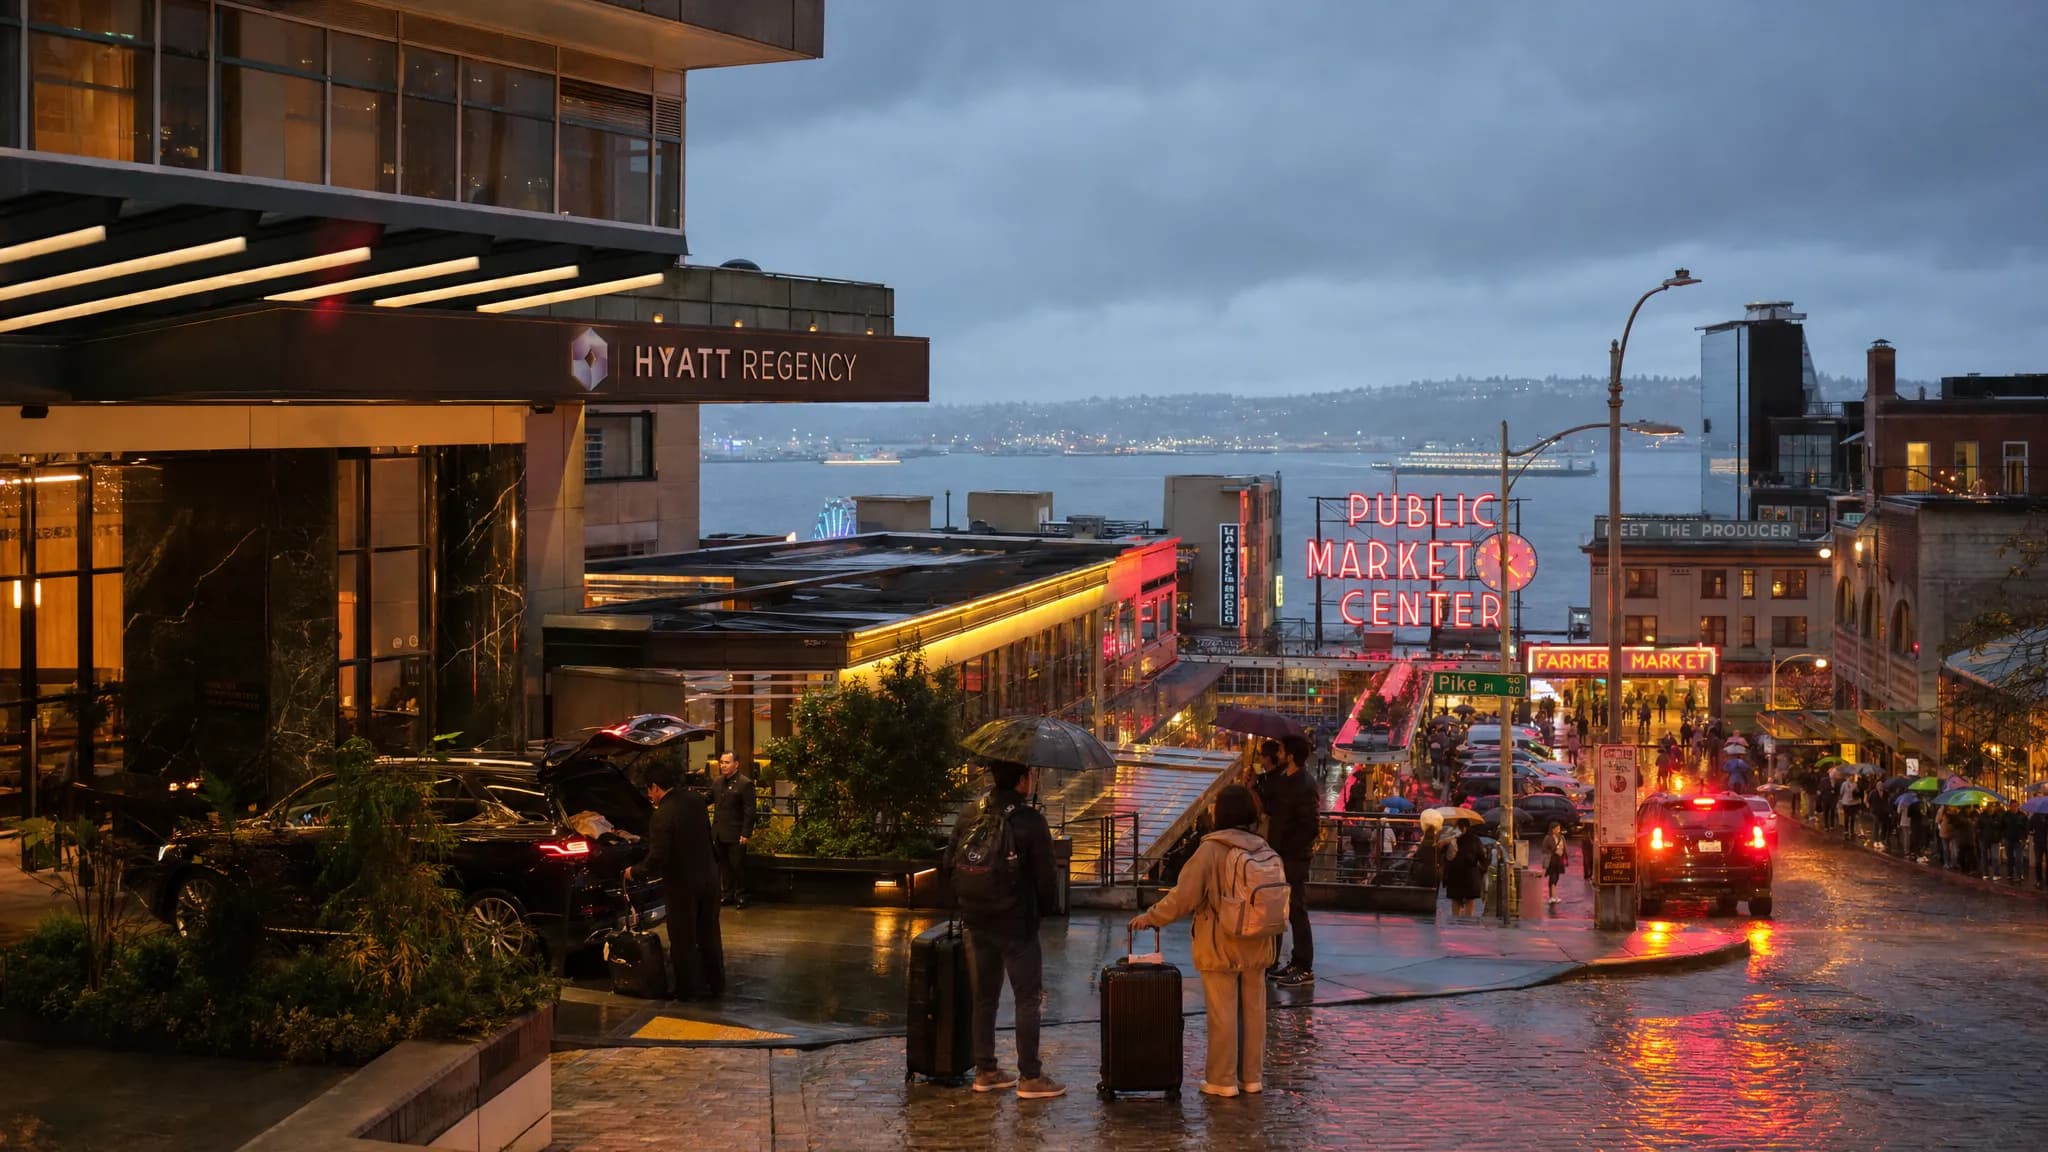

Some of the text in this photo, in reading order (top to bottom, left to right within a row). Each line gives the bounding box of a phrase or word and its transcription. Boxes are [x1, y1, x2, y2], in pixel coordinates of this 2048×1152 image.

[635, 345, 858, 382] HYATT REGENCY
[1349, 493, 1496, 528] PUBLIC
[1659, 523, 1690, 537] THE
[1702, 523, 1792, 537] PRODUCER
[1307, 539, 1474, 580] MARKET
[1340, 589, 1502, 628] CENTER
[1631, 653, 1708, 669] MARKET
[1439, 675, 1478, 692] Pike
